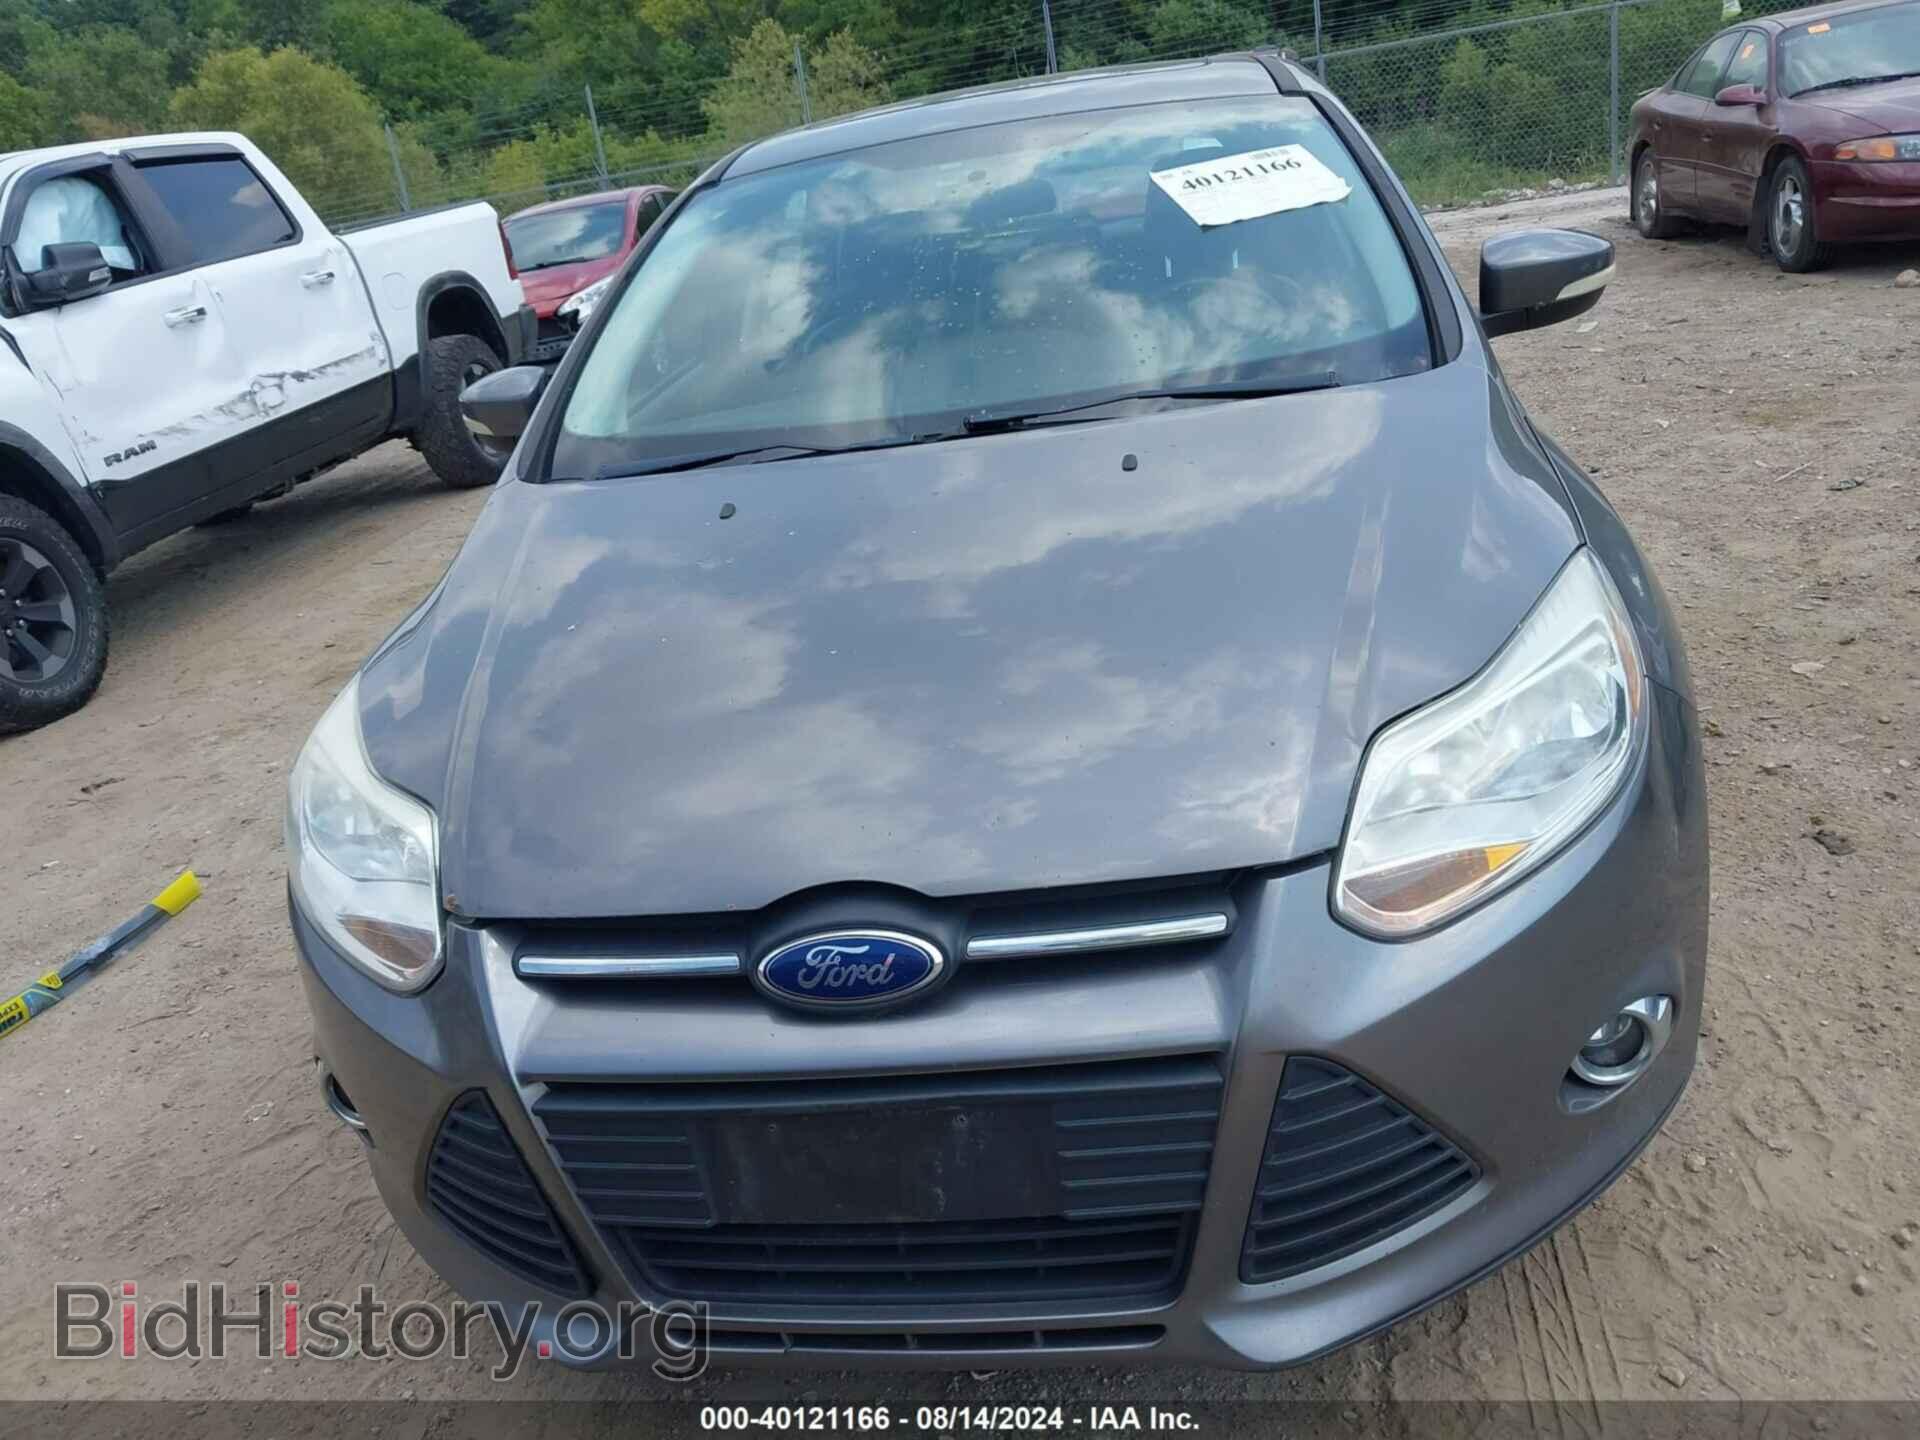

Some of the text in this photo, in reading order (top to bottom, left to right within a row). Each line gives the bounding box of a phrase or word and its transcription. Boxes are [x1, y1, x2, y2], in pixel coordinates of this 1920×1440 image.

[1182, 157, 1302, 192] 40121166
[103, 439, 158, 468] RAM
[797, 944, 897, 990] Ford
